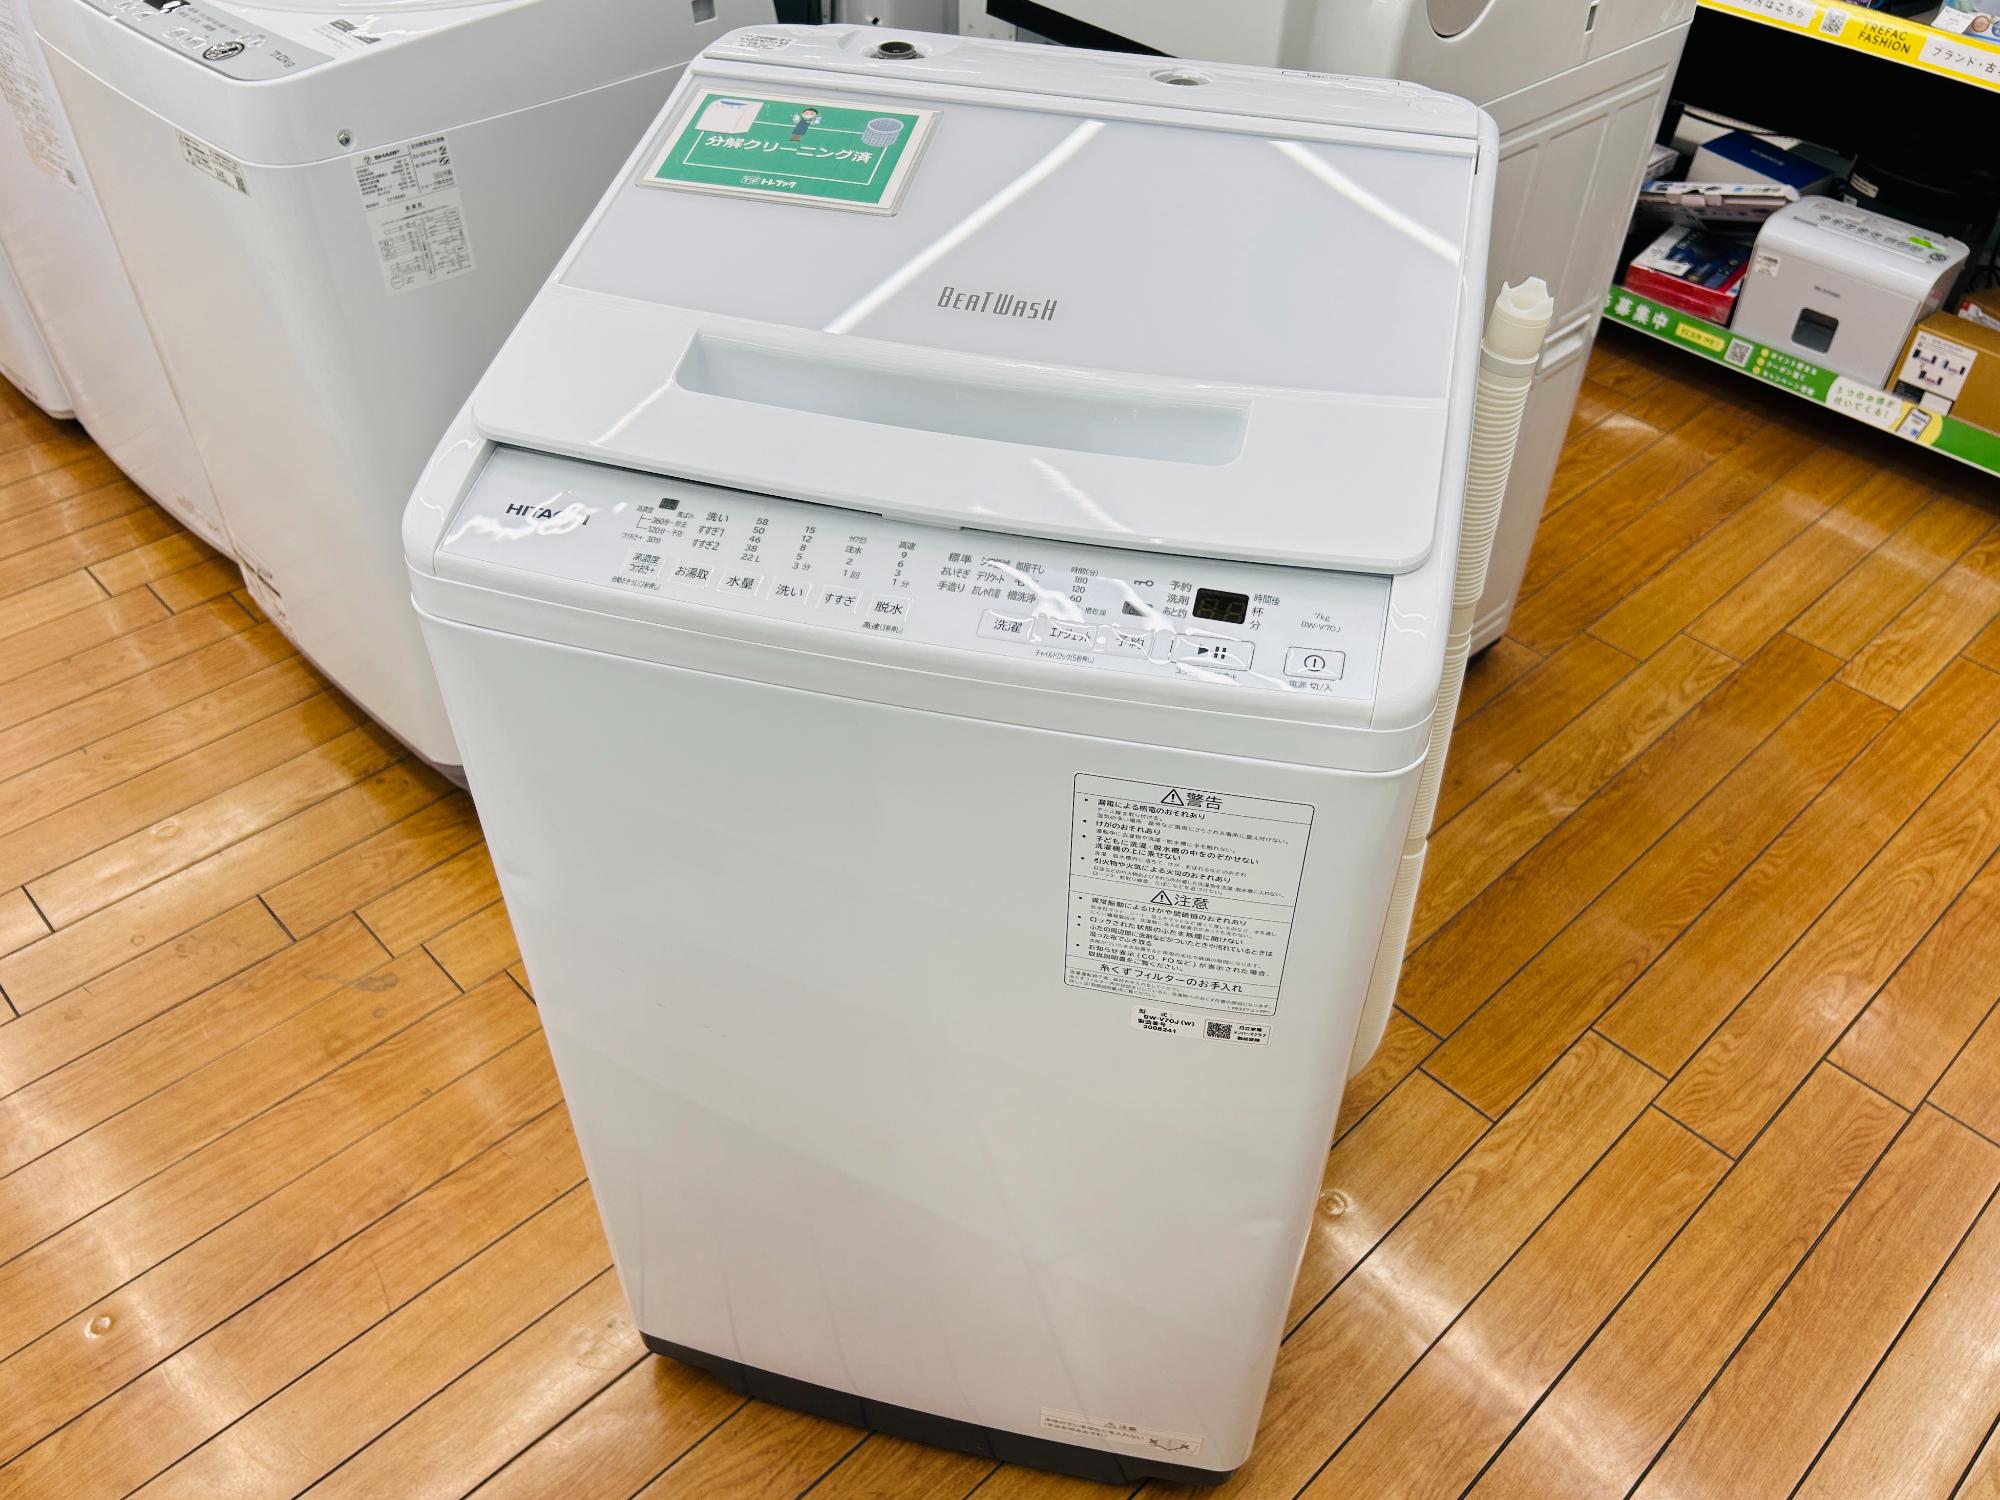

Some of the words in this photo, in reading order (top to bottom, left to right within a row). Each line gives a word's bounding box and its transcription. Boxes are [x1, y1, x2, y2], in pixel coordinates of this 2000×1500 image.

[1863, 21, 1908, 42] TREFAC
[1857, 31, 1911, 54] FASHION
[704, 135, 873, 165] 分解クリーニング済
[705, 511, 729, 522] 洗い
[756, 517, 769, 526] 58
[698, 525, 726, 537] すすぎ1
[752, 526, 765, 535] 50
[805, 526, 816, 535] 15
[691, 538, 720, 551] すすぎ2
[749, 535, 761, 544] 46
[801, 535, 813, 544] 12
[744, 544, 758, 553] 38
[799, 544, 807, 552] 8
[845, 545, 863, 555] 注水
[740, 553, 755, 562] 22
[796, 553, 804, 561] 5
[901, 551, 908, 559] 9
[845, 558, 854, 566] 2
[897, 560, 905, 568] 6
[948, 552, 973, 564] 標準
[1015, 562, 1045, 575] 部屋干し
[675, 565, 710, 580] お湯取
[894, 569, 902, 577] 3
[940, 567, 971, 578] おいそぎ
[976, 571, 1005, 583] デリケート
[1070, 566, 1099, 577] 時間(分)
[726, 576, 755, 590] 水量
[1074, 576, 1088, 585] 180
[775, 584, 803, 597] 洗い
[937, 581, 966, 592] 手造り
[1007, 590, 1037, 603] 槽洗浄
[1071, 585, 1086, 594] 120
[1169, 581, 1193, 593] 予約
[825, 592, 857, 607] すすぎ
[1069, 595, 1082, 603] 60
[1166, 593, 1190, 605] 洗剤
[1253, 594, 1281, 607] 時間後
[873, 600, 903, 615] 脱水
[1162, 606, 1188, 619] あと約
[1250, 607, 1264, 617] 杯
[1314, 612, 1331, 623] 7kg
[993, 619, 1023, 635] 洗濯
[1249, 620, 1261, 631] 分
[1300, 620, 1342, 633] BW-V70J
[1309, 681, 1334, 692] 切/入
[1186, 791, 1223, 811] 警告
[1096, 820, 1162, 836] けがのおそれあり
[1094, 843, 1182, 861] 洗濯機の上に乗せない
[1095, 834, 1260, 865] 子どもに洗濯・脱水槽の中をのぞかせない
[1173, 893, 1209, 911] 注意
[1089, 916, 1245, 945] ロックされた状態のふたを無理に開けない
[1100, 963, 1243, 993] 糸くずフィルターのお手入れ
